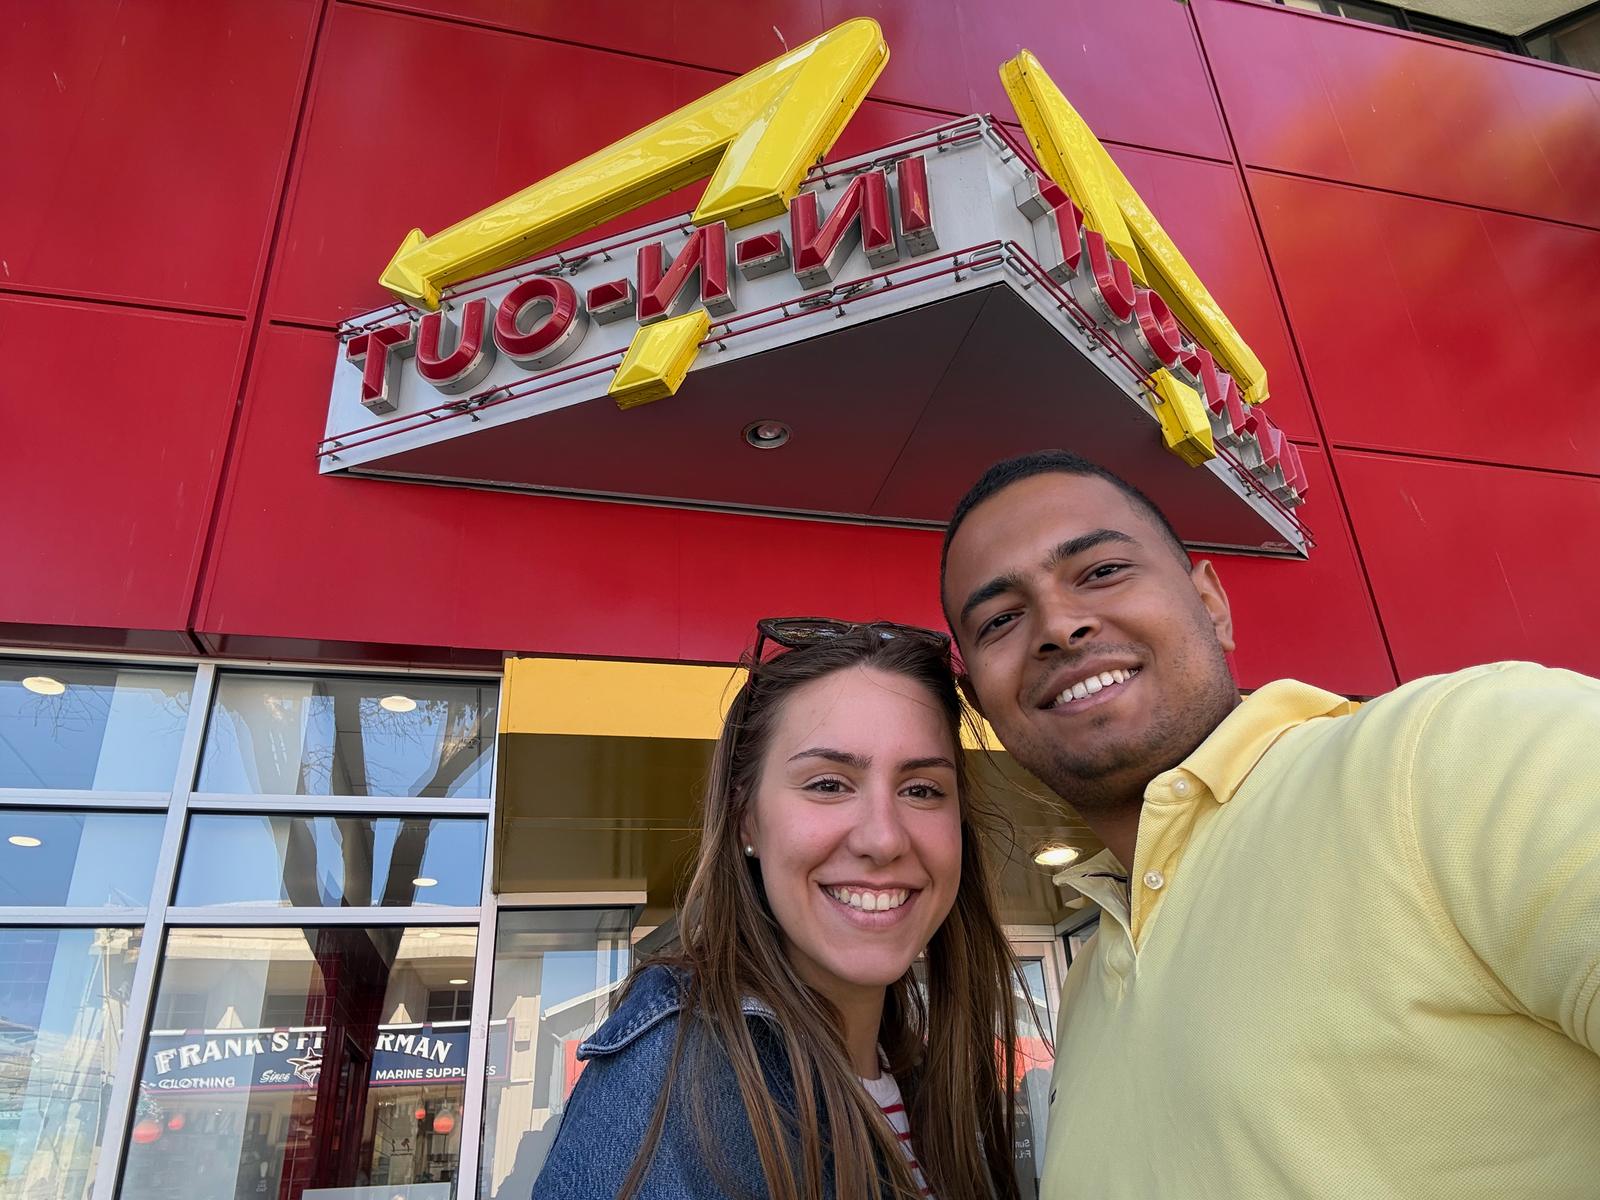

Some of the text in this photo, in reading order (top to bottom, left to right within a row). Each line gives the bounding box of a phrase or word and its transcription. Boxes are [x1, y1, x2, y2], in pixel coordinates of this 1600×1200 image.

[153, 1032, 453, 1075] FRANK'S FIRMAN
[260, 1069, 290, 1083] Since
[376, 1065, 497, 1080] MARINE SUPPLS
[158, 1077, 235, 1089] CLOTHING
